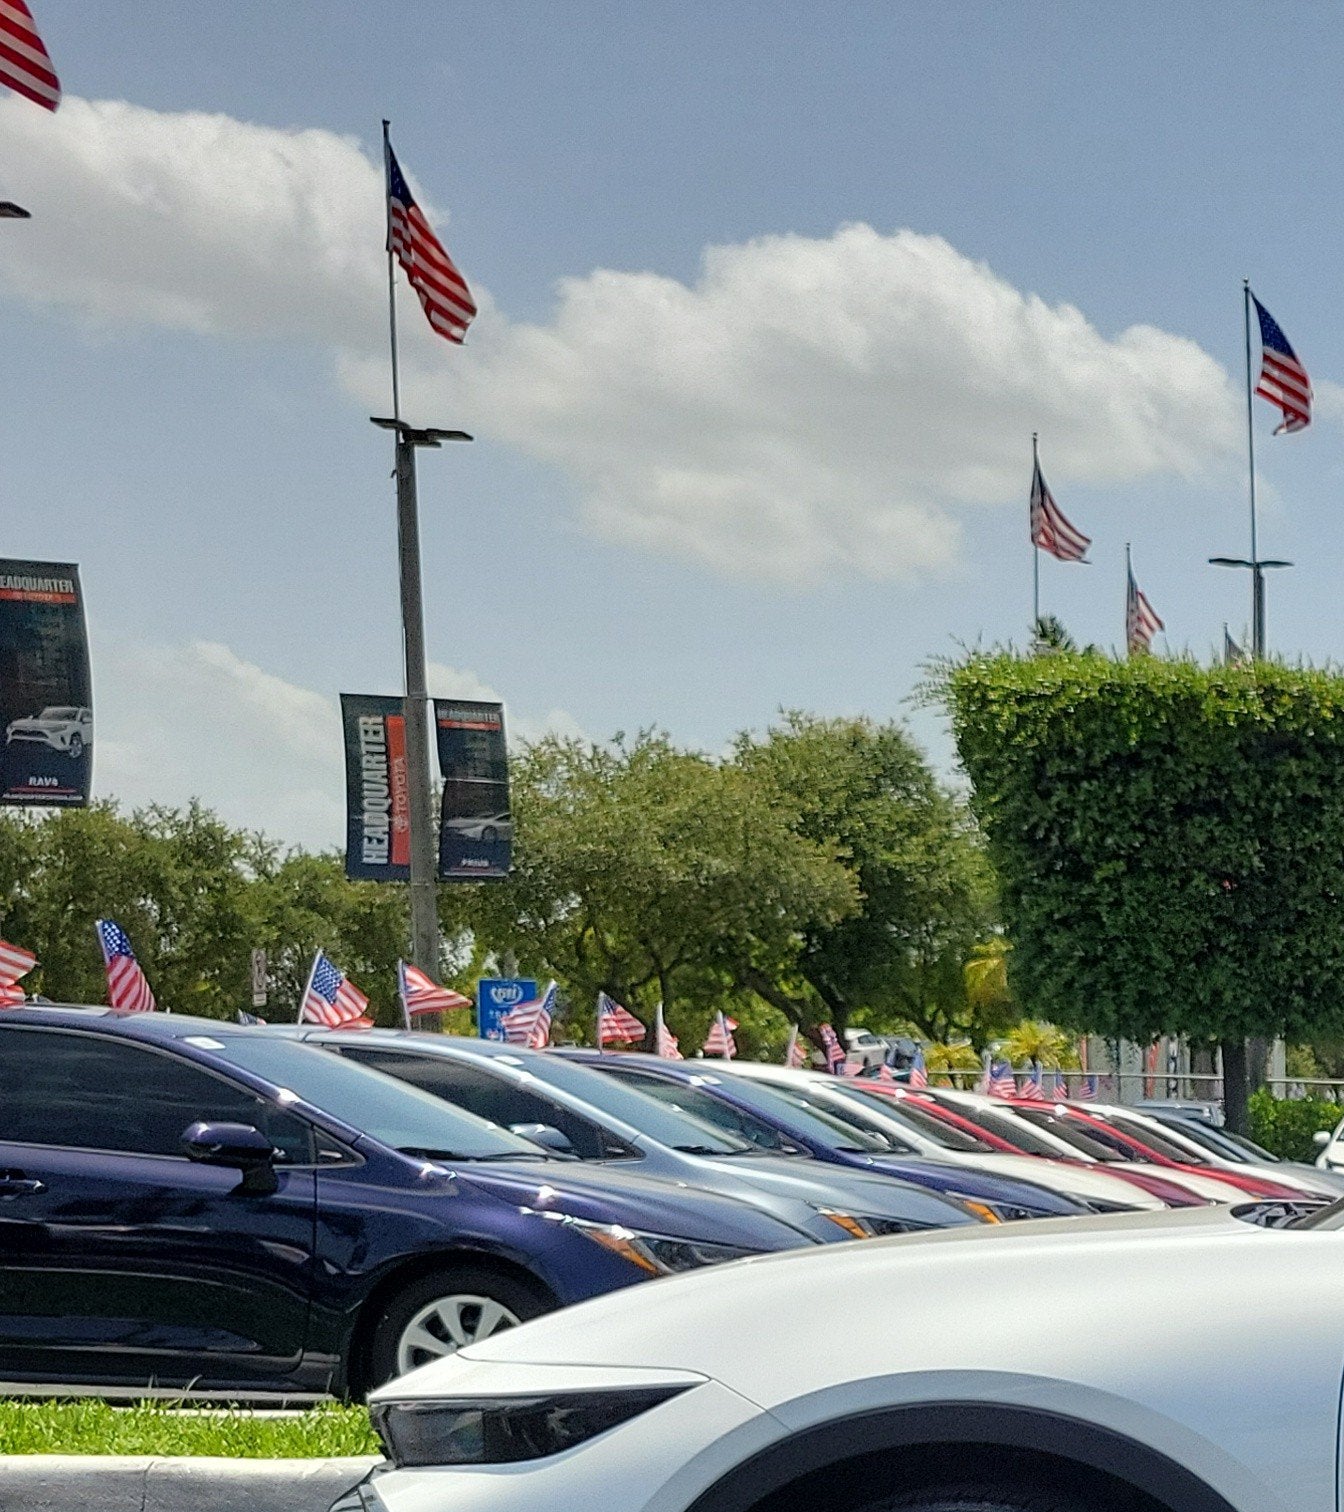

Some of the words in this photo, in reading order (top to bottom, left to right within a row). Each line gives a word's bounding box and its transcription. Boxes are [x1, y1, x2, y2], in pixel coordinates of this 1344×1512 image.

[0, 575, 74, 593] EADQUARTER
[28, 776, 59, 787] RAV4
[359, 716, 391, 864] HEADQUARTER
